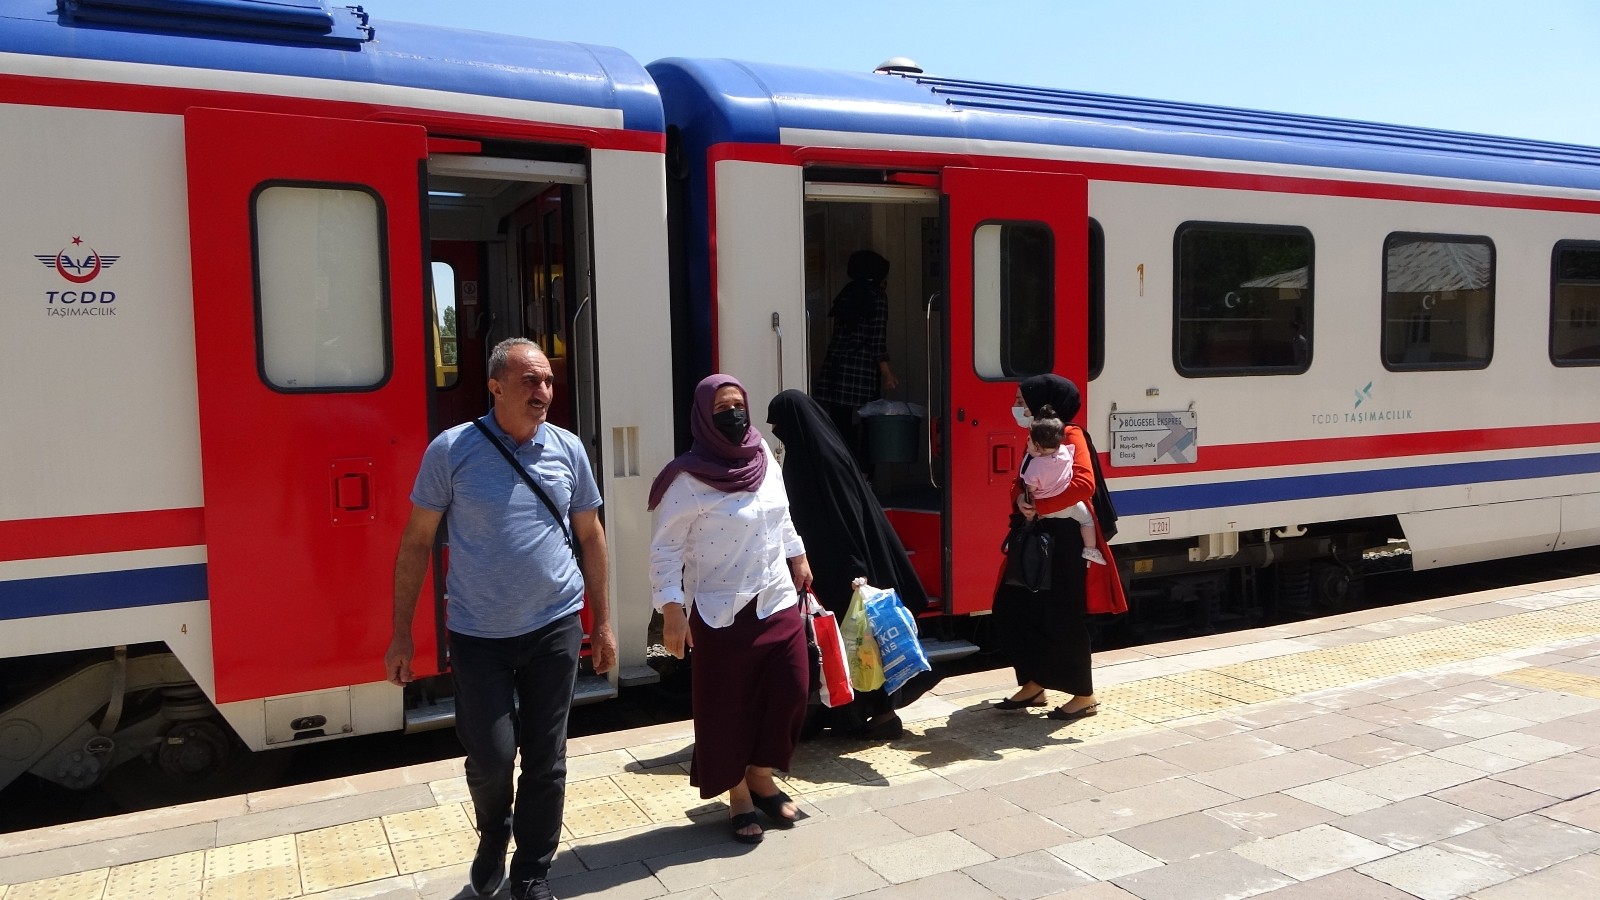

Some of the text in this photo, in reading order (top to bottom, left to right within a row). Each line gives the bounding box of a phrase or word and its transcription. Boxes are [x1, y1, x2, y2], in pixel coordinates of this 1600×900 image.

[1136, 263, 1144, 297] 1
[45, 291, 116, 304] TCDD
[46, 307, 117, 318] TAŞIMACILIK
[1124, 416, 1182, 427] BÖLGESEL EKSPRES
[1311, 409, 1413, 424] TCDD TAŞIMACILIK
[181, 623, 187, 635] 4
